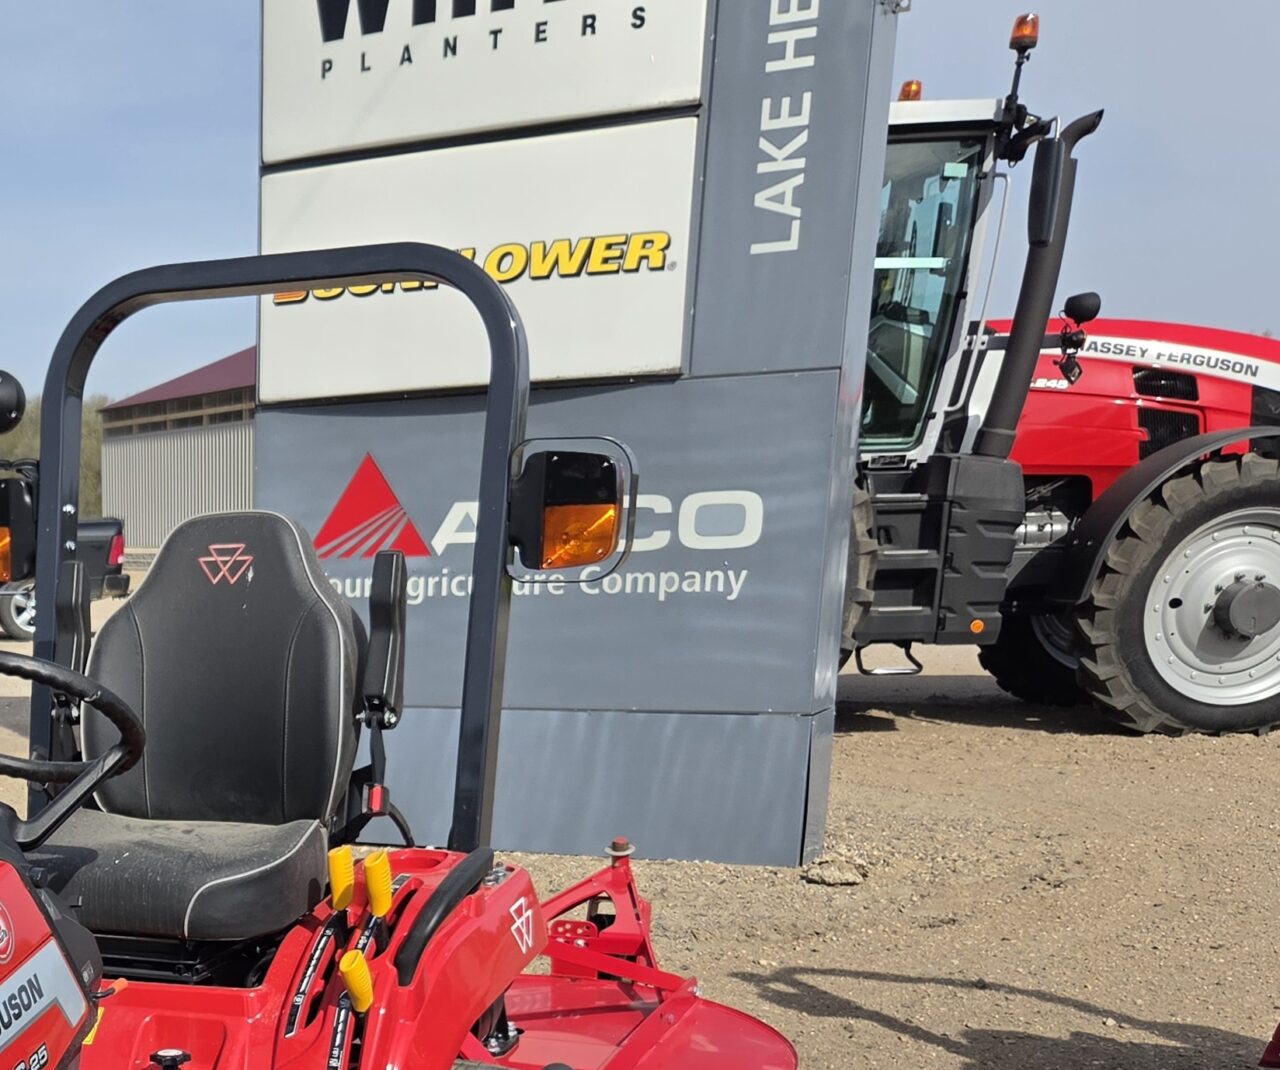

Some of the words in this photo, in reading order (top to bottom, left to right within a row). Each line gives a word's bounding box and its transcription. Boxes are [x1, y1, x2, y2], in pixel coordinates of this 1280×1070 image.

[320, 6, 647, 80] PLANTERS
[749, 90, 813, 255] LAKE
[431, 489, 764, 557] ACO
[324, 572, 373, 599] our
[405, 568, 566, 606] gricure
[579, 566, 748, 601] Company
